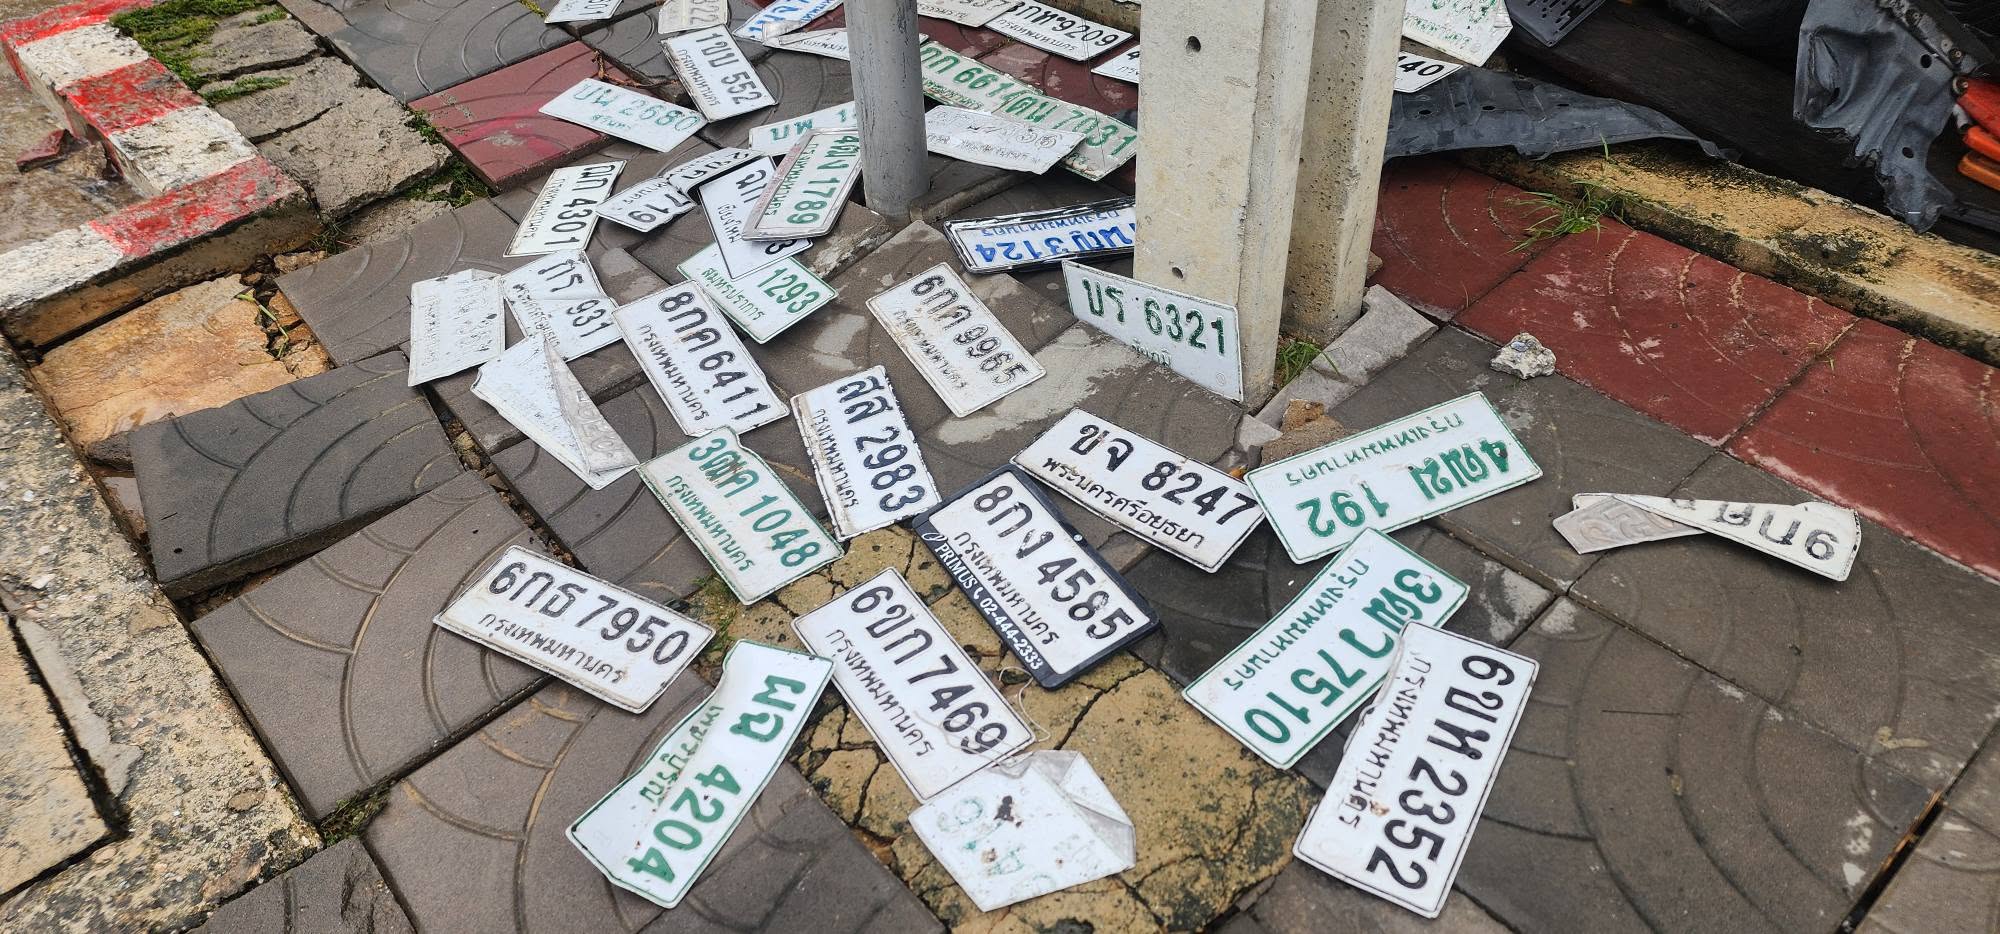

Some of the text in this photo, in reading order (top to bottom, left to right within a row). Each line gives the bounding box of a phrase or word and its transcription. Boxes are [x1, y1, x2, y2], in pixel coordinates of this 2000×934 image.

[677, 49, 720, 107] กรุงเทพมหานคร
[720, 69, 762, 106] 552
[1399, 56, 1444, 77] 40
[618, 98, 703, 132] 2680
[523, 178, 567, 240] กรุงเทพมหานคร
[544, 197, 598, 246] 4301
[626, 192, 691, 224] 719
[717, 203, 744, 244] เชียงใหม
[786, 176, 841, 224] 1789
[973, 222, 1136, 264] นญ 3124
[565, 298, 615, 339] 931
[700, 266, 768, 322] สมุทรปราการ
[757, 266, 822, 315] 1293
[1142, 296, 1226, 356] 6321
[638, 323, 714, 423] กรุงเทพมหานคร
[698, 349, 774, 421] 6411
[953, 322, 1030, 386] 9965
[813, 408, 860, 509] กรุงเทพมหานคร
[855, 425, 928, 512] 2983
[1069, 423, 1260, 527] ขจ 8247
[1285, 411, 1466, 488] กรุงเทพมหานคร
[664, 473, 756, 573] กรุงเทพมหานคร
[738, 494, 822, 569] 1048
[1041, 454, 1207, 552] พระนครศรีอยุธยา
[1295, 478, 1391, 538] 192
[952, 529, 1060, 646] กรุงเทพมหานคร
[973, 483, 1136, 641] 8กง 4585
[487, 560, 690, 667] 6กธ 7950
[935, 536, 1046, 672] PRIMUS 02-444-2333
[1223, 558, 1370, 692] กรุงเทพมหานคร
[478, 611, 628, 685] กรุงเทพมหานคร
[849, 584, 935, 668] 6ขก
[907, 653, 1010, 756] 7469
[824, 627, 938, 759] กรุงเทพมหานคร
[1243, 648, 1368, 745] 7510
[1338, 652, 1433, 829] กรุงเทพมหานคร
[625, 761, 743, 885] 4204
[1365, 756, 1470, 891] 2352
